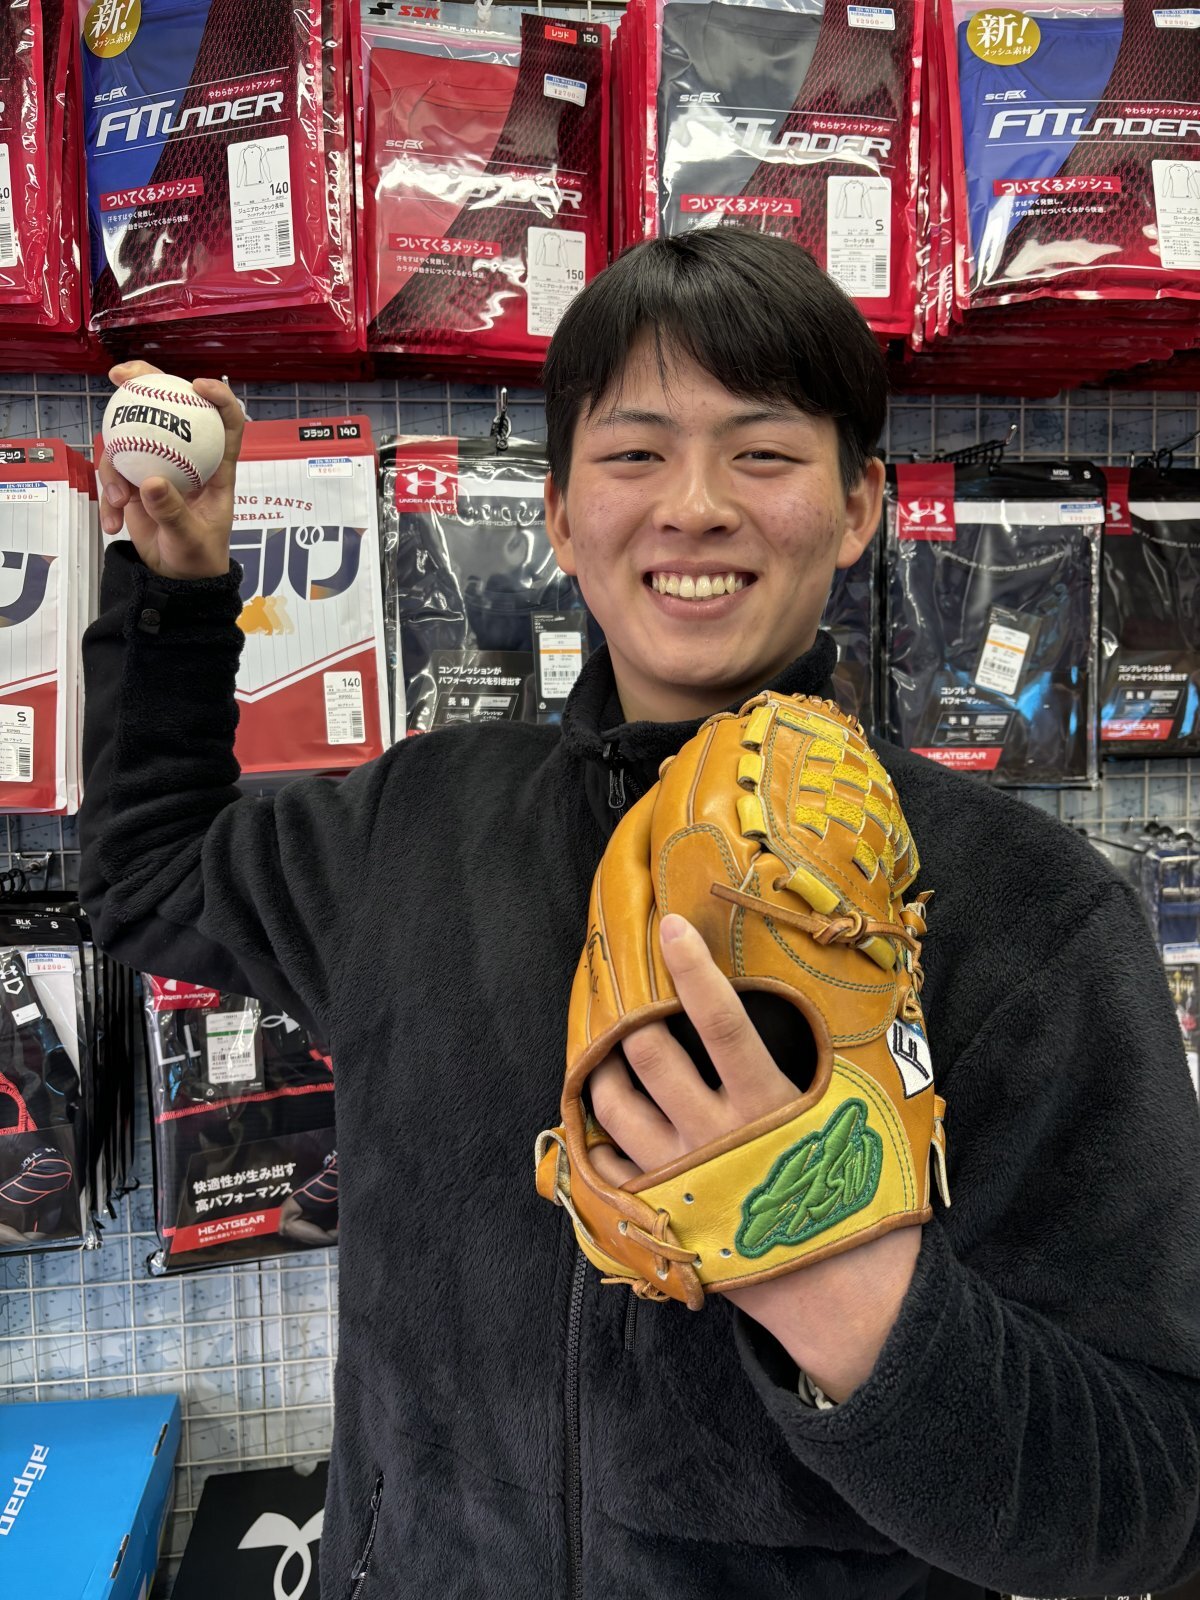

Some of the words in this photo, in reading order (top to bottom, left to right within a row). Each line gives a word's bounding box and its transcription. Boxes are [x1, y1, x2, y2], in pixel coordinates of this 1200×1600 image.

[397, 5, 440, 20] SSK
[551, 29, 570, 39] レッド
[976, 13, 1030, 49] 新!
[582, 33, 599, 44] 150
[982, 46, 1032, 58] メッシュ素材
[208, 78, 282, 99] やわらかフィットアンダー
[812, 121, 890, 132] やわらかフィットアンダー
[269, 181, 289, 196] 140
[1001, 178, 1113, 194] ついてくるメッシュ
[106, 182, 198, 207] ついてくるメッシュ
[688, 197, 794, 214] ついてくるメッシュ
[875, 219, 885, 231] S
[396, 236, 494, 256] ついてくるメッシュ
[566, 269, 584, 281] 150
[110, 405, 192, 443] FIGHTERS
[303, 428, 331, 439] ブラック
[339, 426, 357, 437] 140
[37, 450, 46, 460] S
[1053, 469, 1069, 477] MDN
[1083, 470, 1092, 480] S
[264, 496, 313, 511] PANTS
[233, 511, 284, 521] SEBALL
[438, 666, 502, 675] コンプレッションが
[342, 677, 361, 688] 140
[438, 676, 522, 687] パフォーマンスを引き出す
[17, 711, 26, 722] S
[928, 751, 987, 760] HEATGEAR
[50, 921, 59, 929] S
[193, 1163, 296, 1194] 快適性が生み出す
[195, 1182, 293, 1213] 高パフォーマンス
[198, 1214, 266, 1236] HEATGEAR
